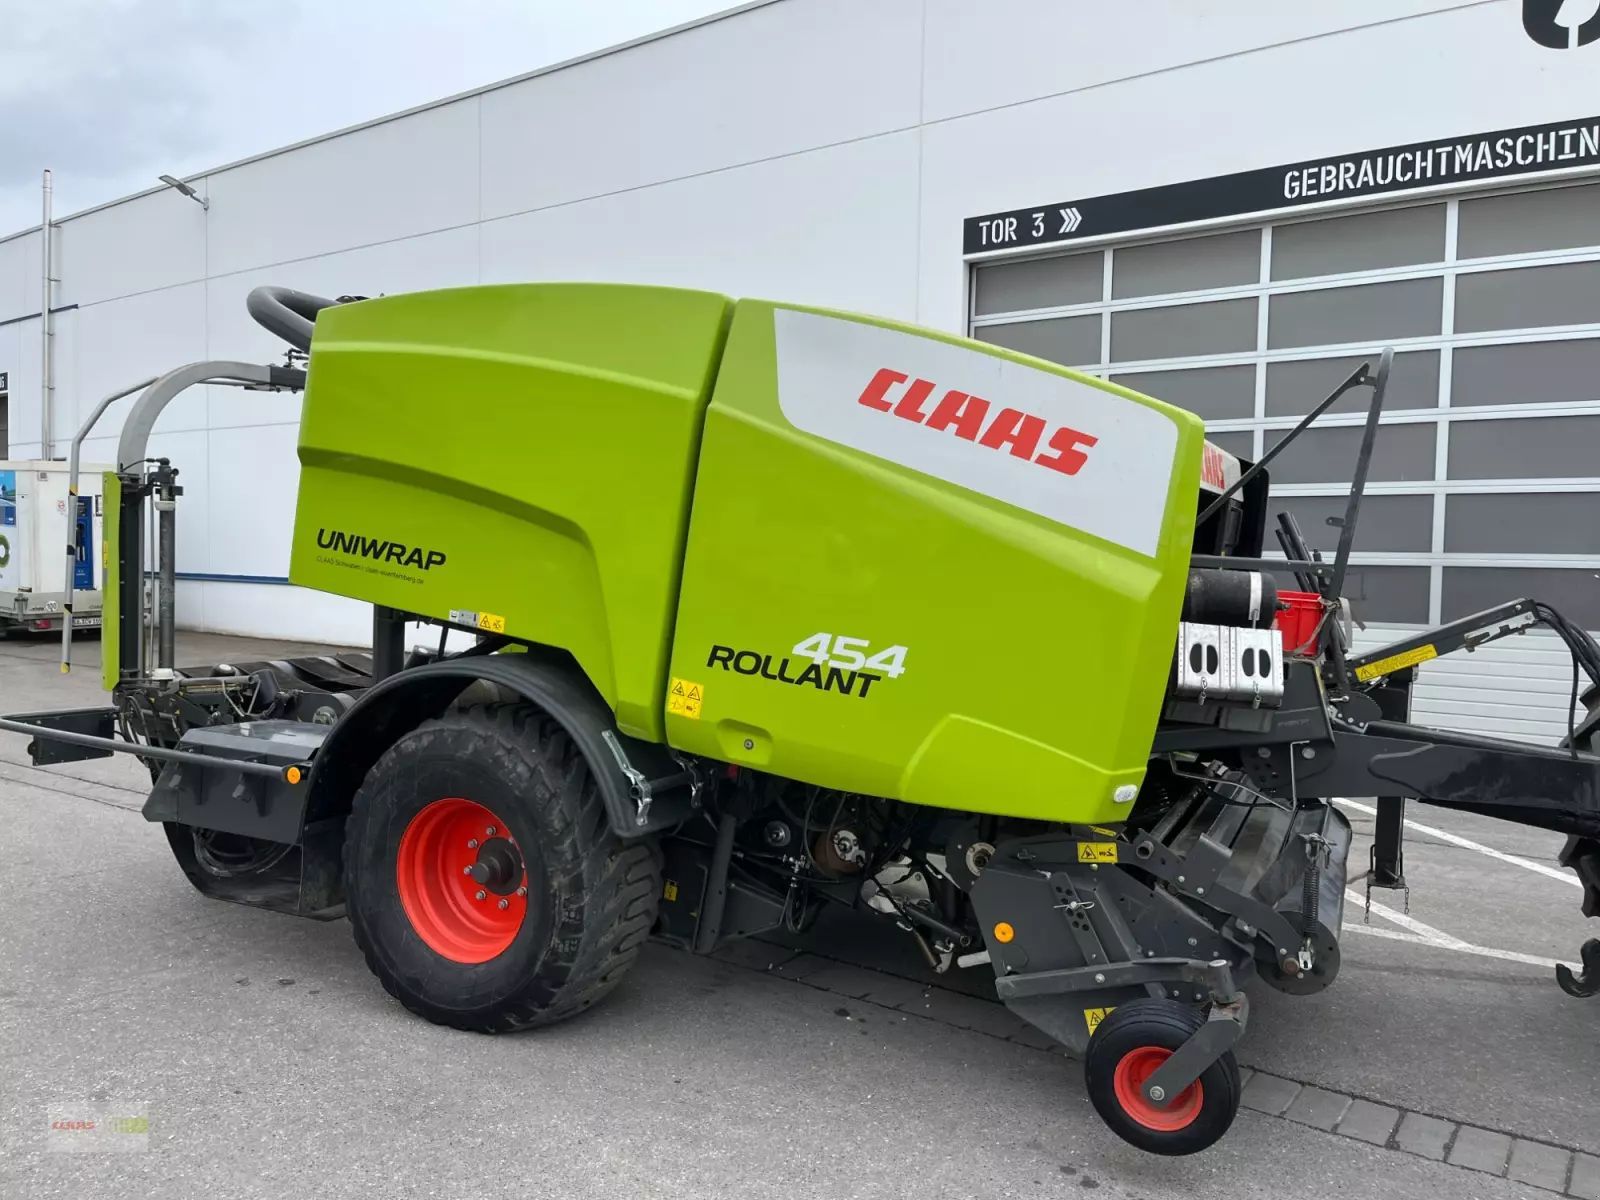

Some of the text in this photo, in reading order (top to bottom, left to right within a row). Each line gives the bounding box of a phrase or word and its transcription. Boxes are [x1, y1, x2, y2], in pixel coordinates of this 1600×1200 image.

[1284, 125, 1600, 199] GEBRAUCHTMASCHIN
[979, 212, 1045, 245] TOR 3
[858, 367, 1099, 476] CLAAS
[316, 528, 447, 571] UNIWRAP
[706, 644, 882, 699] ROLLANT
[792, 632, 908, 679] 454
